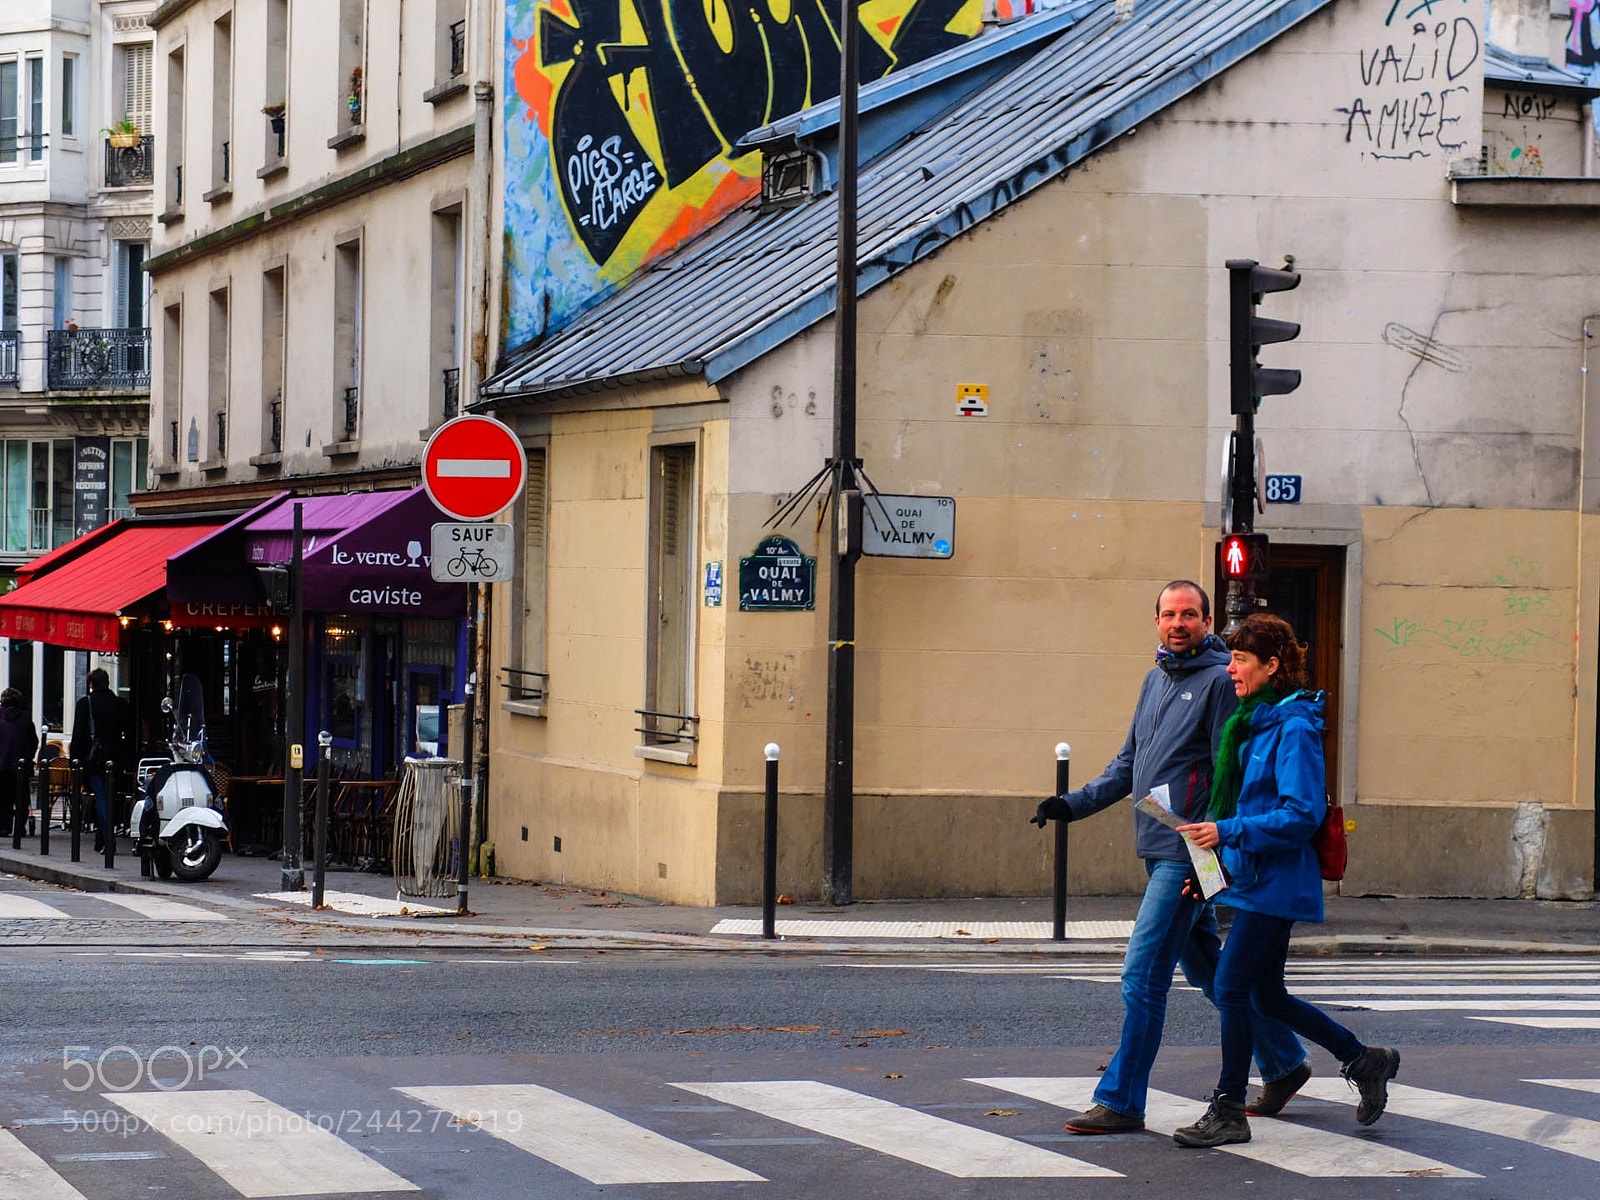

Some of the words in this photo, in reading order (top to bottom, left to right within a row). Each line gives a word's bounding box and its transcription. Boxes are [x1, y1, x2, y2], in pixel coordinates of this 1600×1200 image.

[597, 161, 656, 230] LARGE
[1266, 477, 1296, 501] 85
[895, 508, 922, 518] QUAI
[901, 520, 916, 529] DE
[451, 528, 494, 542] SAUF
[880, 530, 935, 544] VALMY
[331, 544, 354, 565] le
[356, 552, 407, 567] verre
[758, 566, 797, 580] QUAI
[771, 580, 783, 588] DE
[349, 585, 422, 606] caviste
[750, 588, 805, 602] VALMY
